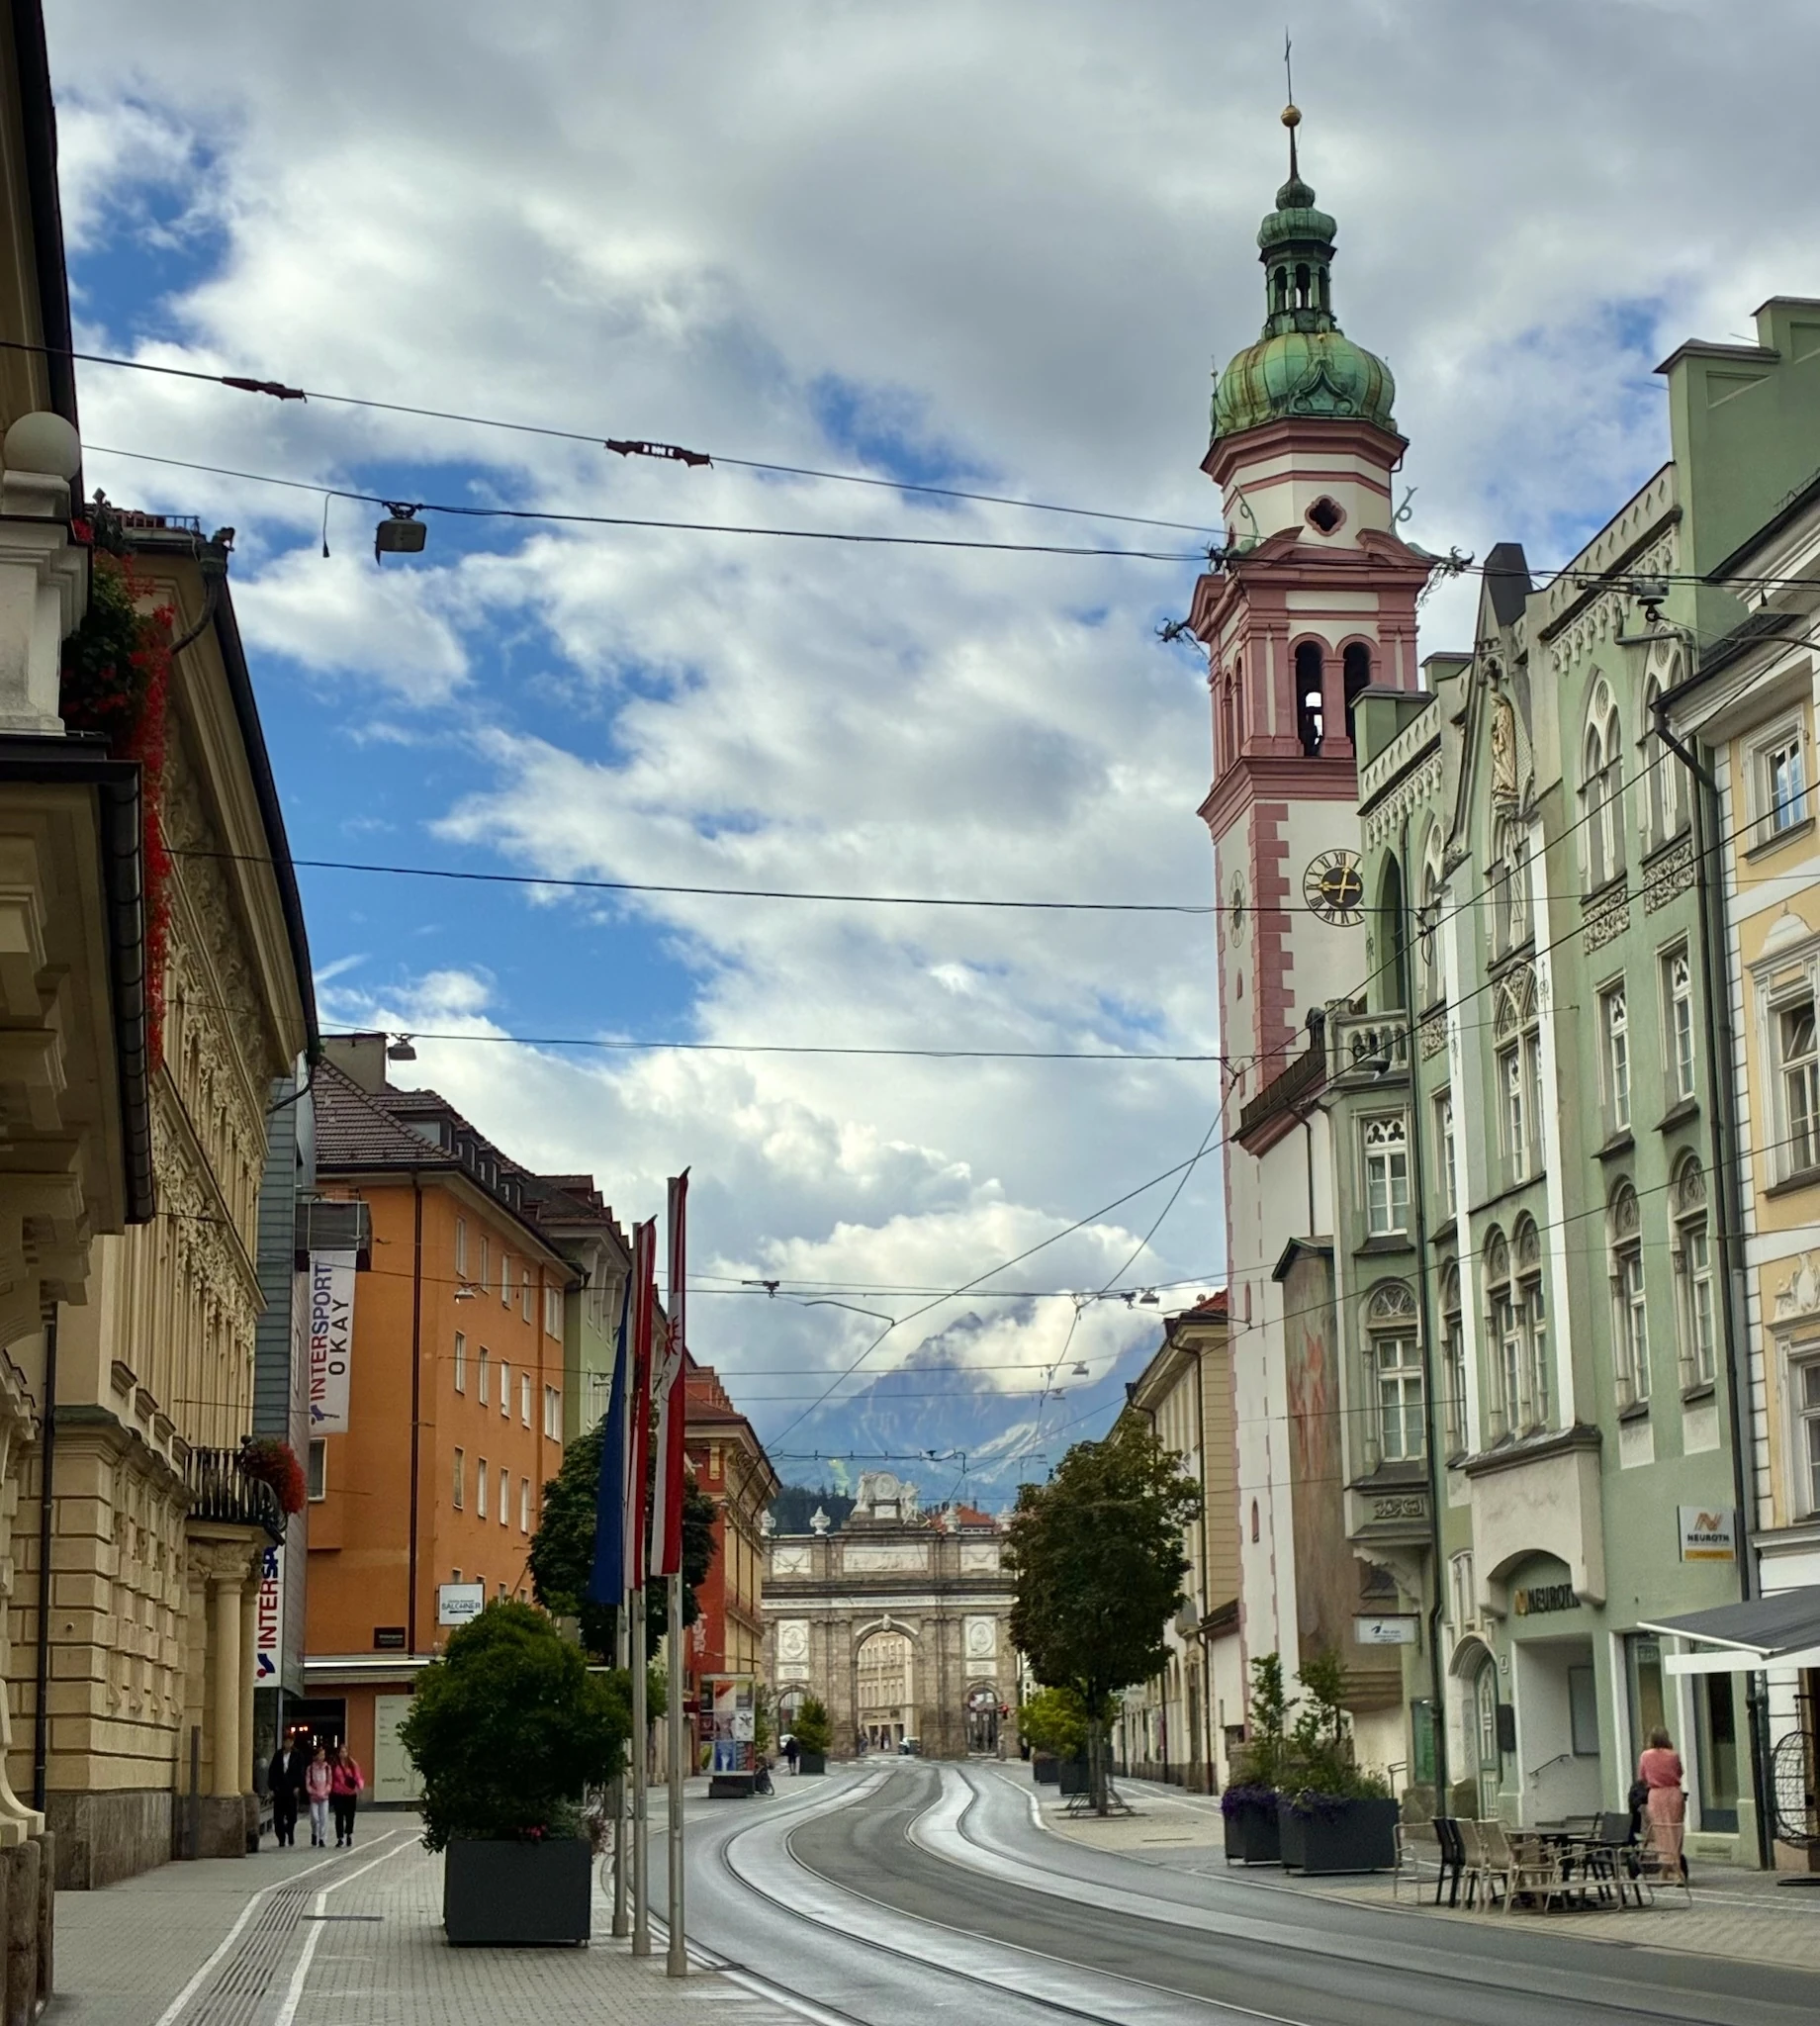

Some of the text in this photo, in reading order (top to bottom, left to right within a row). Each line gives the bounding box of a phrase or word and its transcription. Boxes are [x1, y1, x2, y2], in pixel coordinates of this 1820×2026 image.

[310, 1263, 332, 1401] INTERSPORT
[328, 1298, 349, 1375] OKAY
[1687, 1533, 1729, 1542] NEUROTH
[257, 1540, 278, 1650] INTERSP
